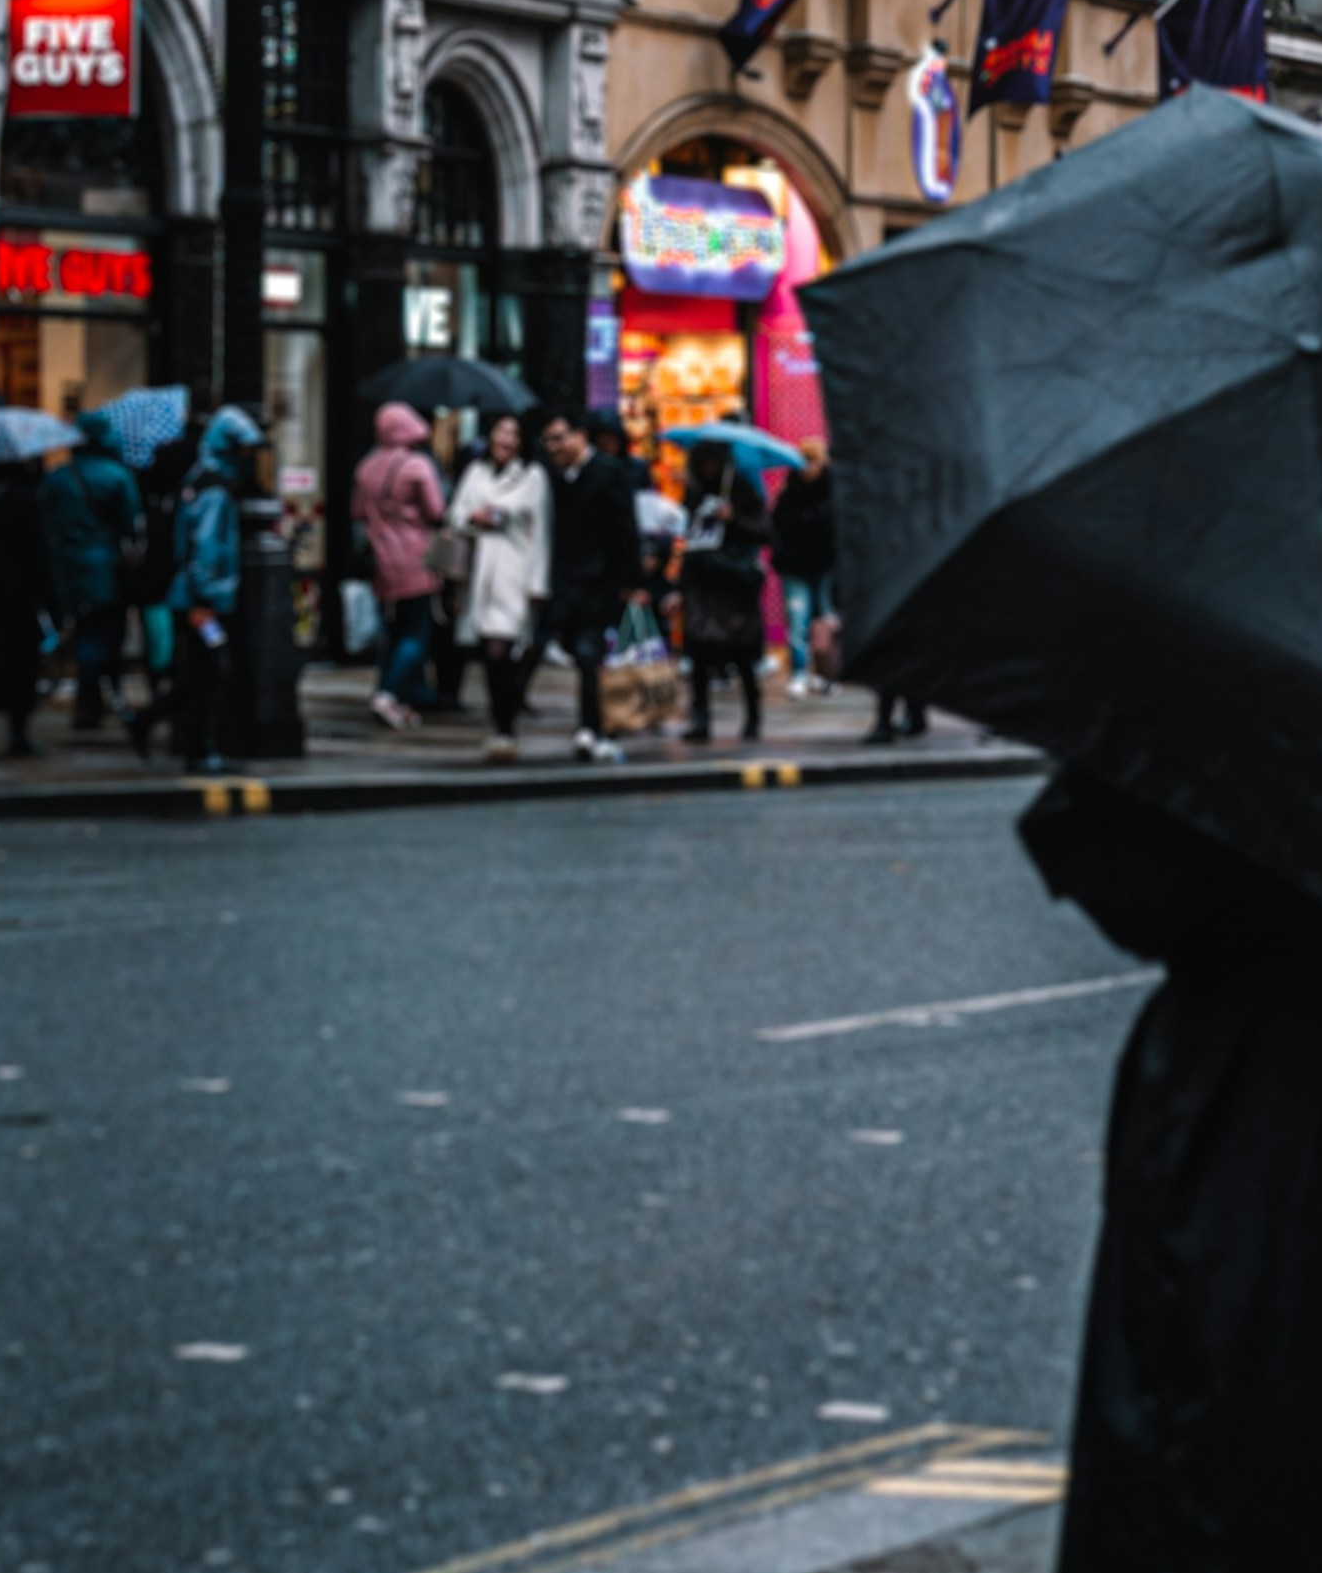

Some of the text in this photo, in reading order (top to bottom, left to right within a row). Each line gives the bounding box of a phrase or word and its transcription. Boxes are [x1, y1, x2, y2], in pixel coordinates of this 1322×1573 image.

[23, 16, 114, 50] FIVE
[12, 52, 124, 86] GUYS
[59, 250, 152, 300] GUYS
